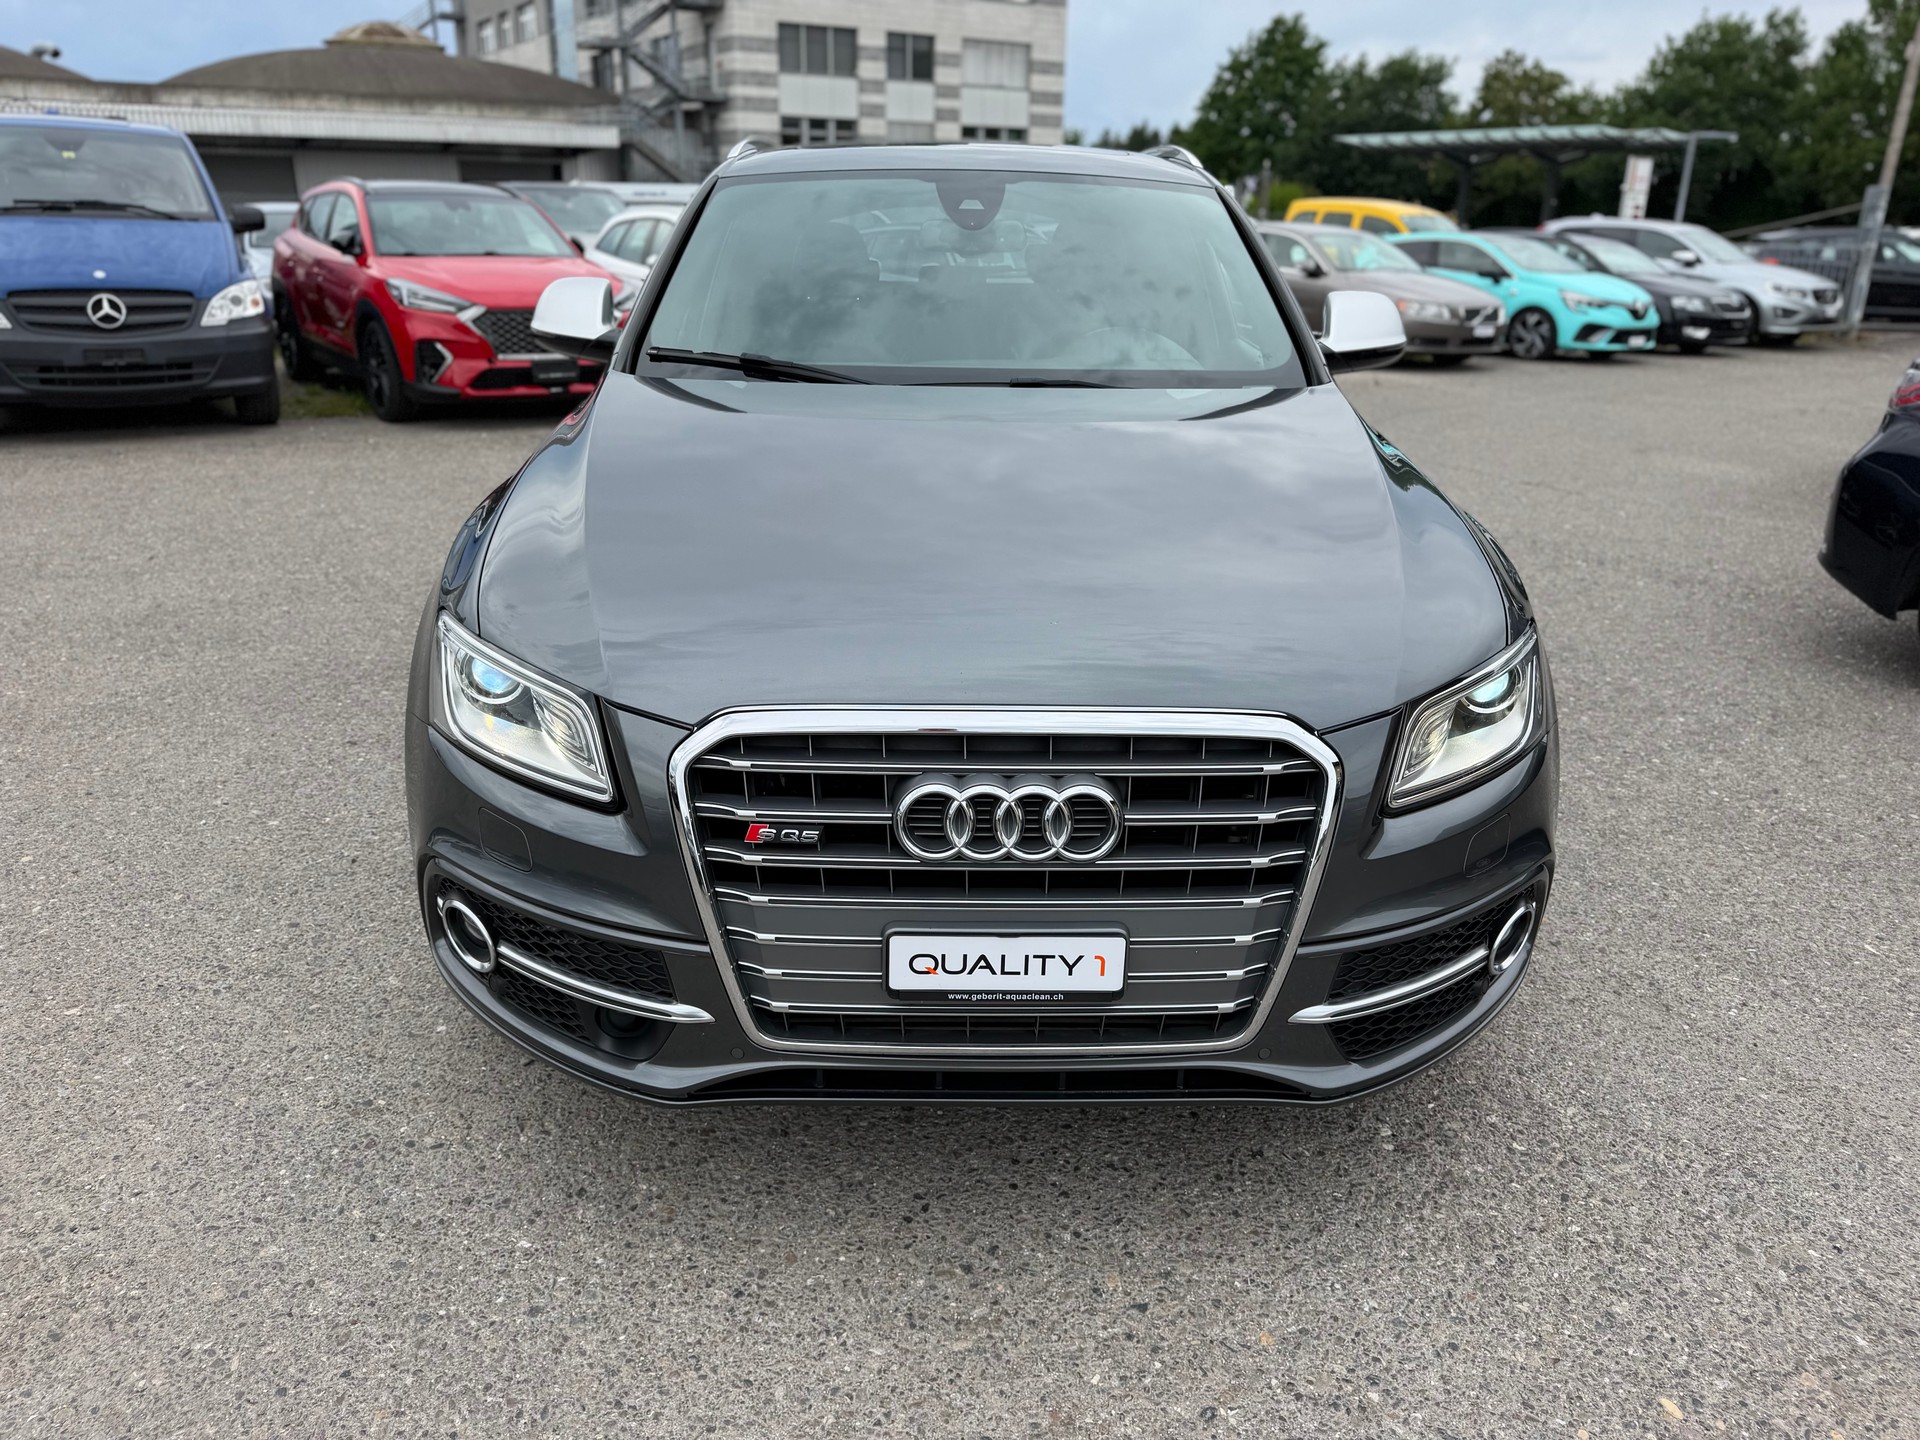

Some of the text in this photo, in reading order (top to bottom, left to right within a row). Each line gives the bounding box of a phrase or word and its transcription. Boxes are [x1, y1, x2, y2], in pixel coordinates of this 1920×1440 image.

[908, 953, 1106, 977] QUALITY 1
[947, 992, 1064, 1001] www.geberit-aquaclean.ch
